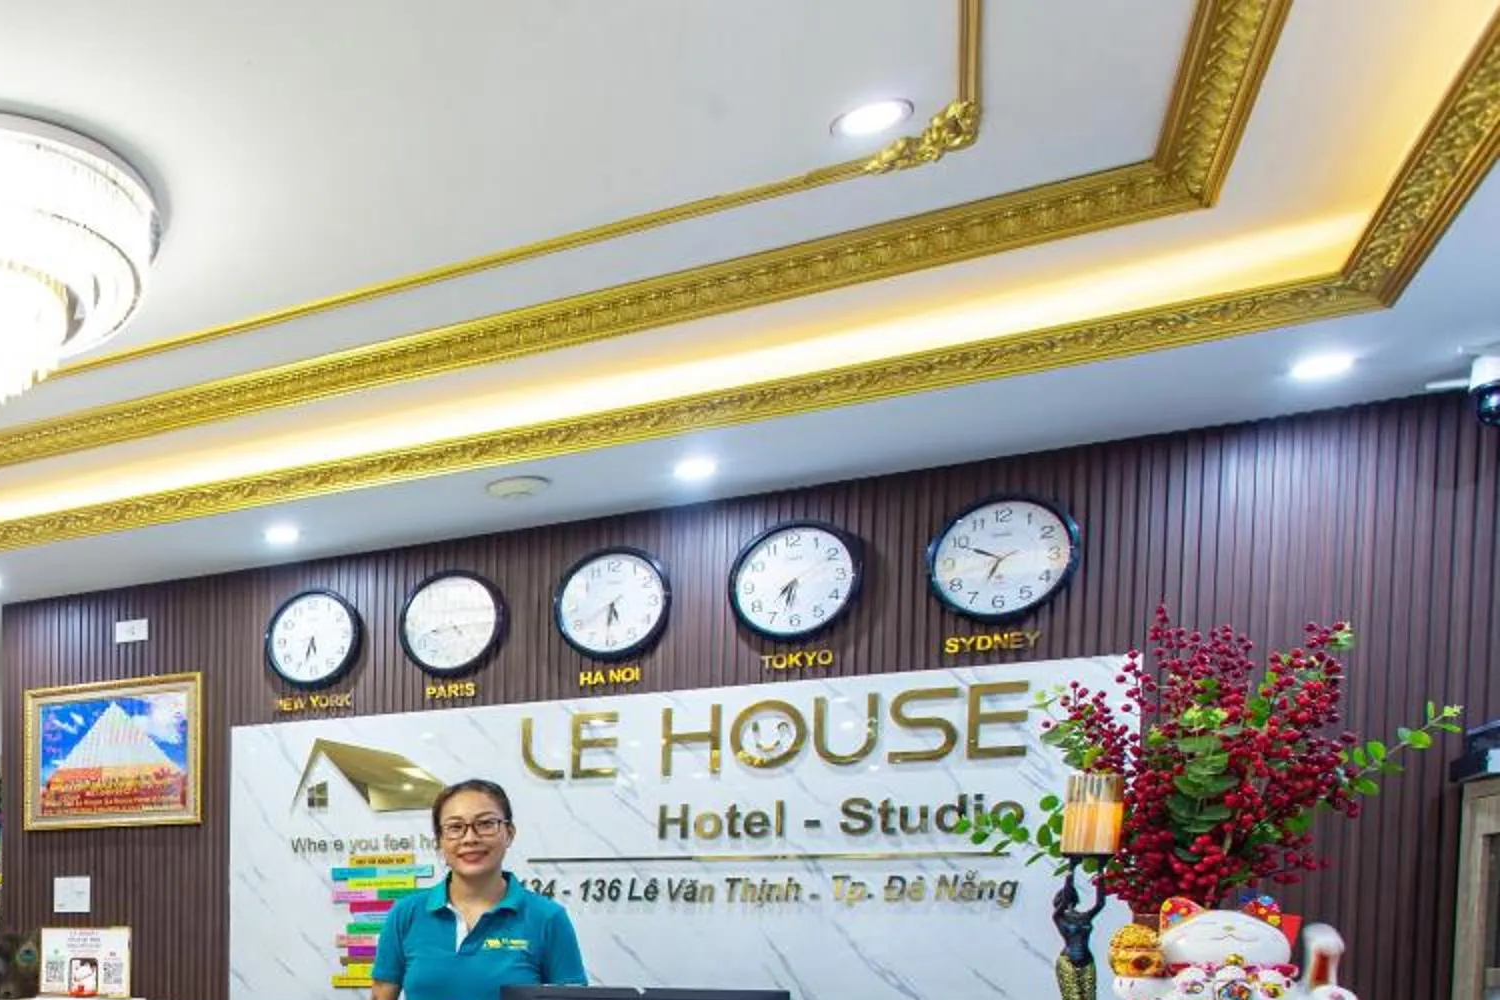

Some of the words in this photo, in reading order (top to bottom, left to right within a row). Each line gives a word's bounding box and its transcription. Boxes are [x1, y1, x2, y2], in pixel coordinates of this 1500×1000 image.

[995, 508, 1012, 522] 12
[1028, 512, 1032, 525] 1
[972, 518, 984, 531] 11
[1041, 525, 1056, 539] 2
[785, 536, 800, 547] 12
[814, 537, 819, 547] 1
[952, 536, 970, 548] 10
[767, 544, 777, 556] 11
[827, 548, 838, 560] 2
[1048, 547, 1061, 560] 3
[751, 560, 764, 572] 10
[836, 568, 846, 580] 3
[1038, 569, 1051, 582] 4
[744, 582, 755, 594] 9
[949, 578, 962, 592] 8
[829, 588, 839, 600] 4
[968, 592, 978, 604] 7
[1019, 586, 1033, 600] 5
[751, 600, 762, 613] 8
[992, 595, 1004, 608] 6
[768, 612, 778, 624] 7
[813, 605, 824, 618] 5
[789, 614, 800, 626] 6
[945, 631, 1041, 653] SYDNEY
[761, 650, 833, 669] TOKYO
[580, 671, 605, 686] HA
[609, 666, 641, 682] NOI
[425, 682, 476, 698] PARIS
[309, 692, 352, 707] YORK
[521, 711, 619, 780] LE
[661, 680, 1029, 777] HOUSE
[658, 800, 785, 840] Hotel
[839, 793, 1025, 836] Studio
[291, 837, 344, 853] Whee
[349, 837, 379, 854] you
[580, 878, 622, 902] 136
[628, 877, 660, 901] Lê
